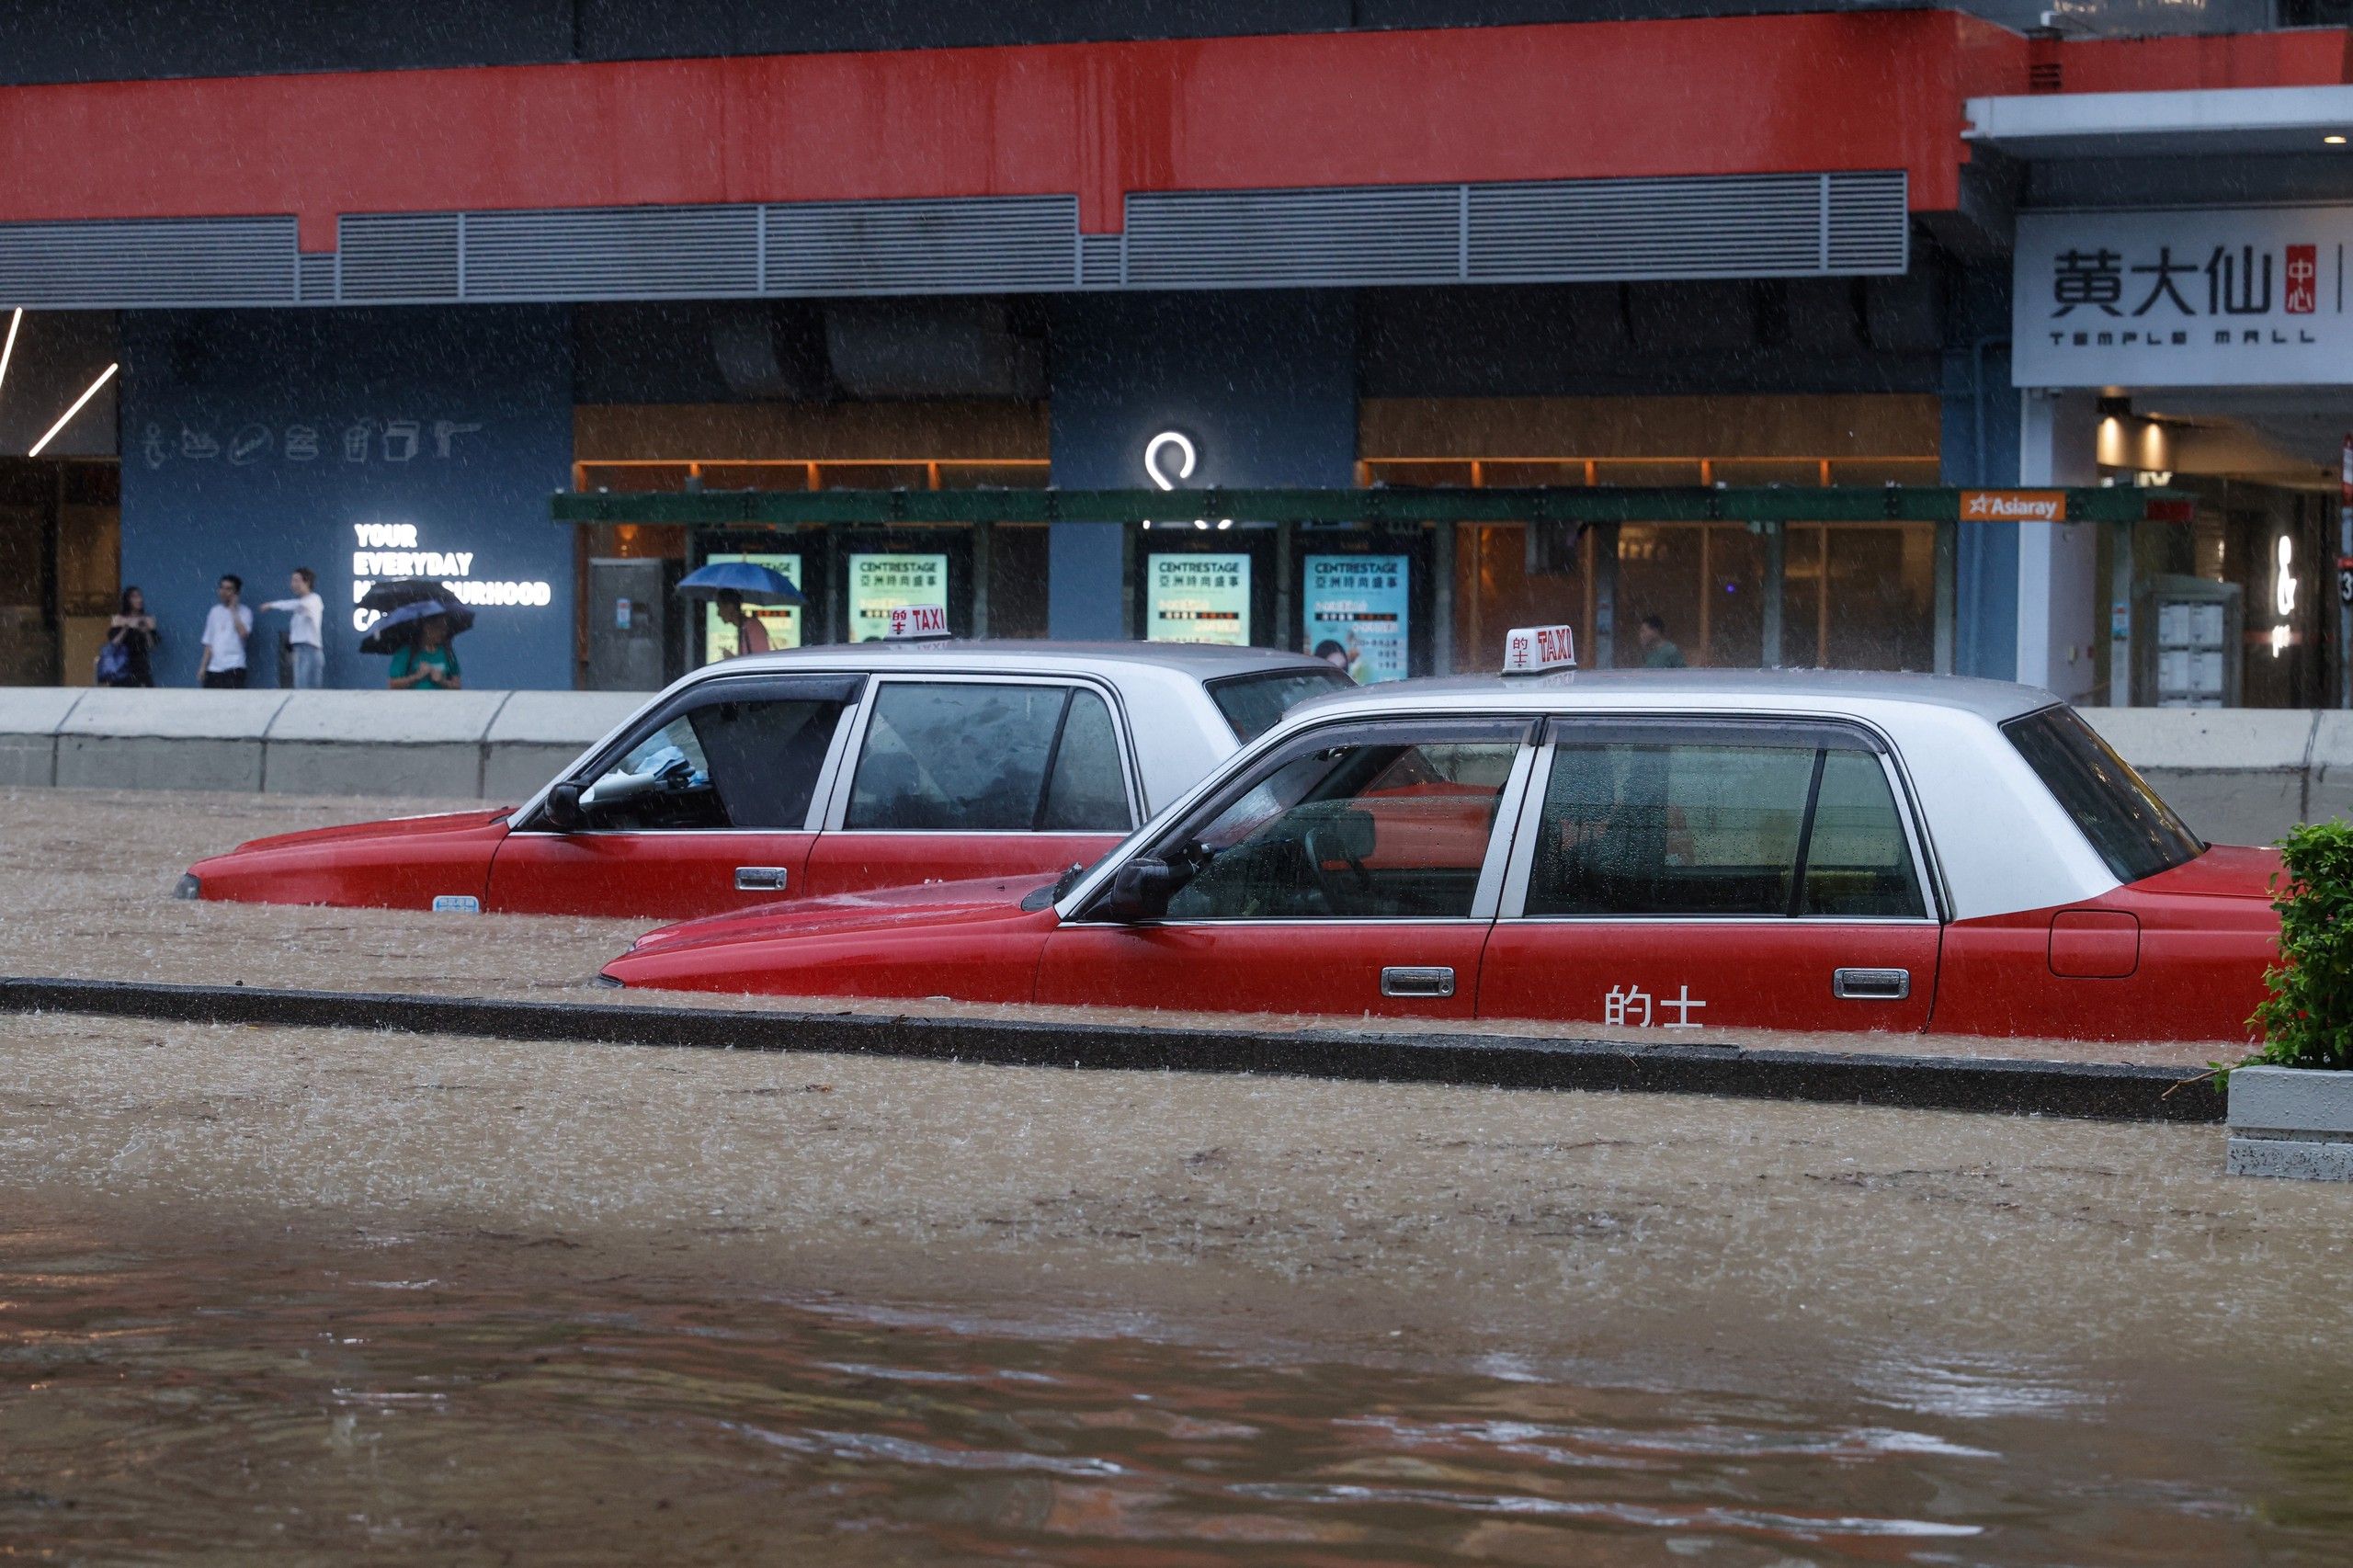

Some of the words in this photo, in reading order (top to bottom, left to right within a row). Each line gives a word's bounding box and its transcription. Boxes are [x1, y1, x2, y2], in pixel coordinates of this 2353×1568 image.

[2288, 258, 2313, 312] 中心
[2050, 331, 2188, 346] TEMPLE
[2215, 329, 2316, 345] MALL
[1991, 497, 2058, 519] Asiaray
[354, 523, 418, 548] YOUR
[353, 551, 474, 576] EVERYDAY
[860, 562, 937, 573] CENTRESTAGE
[1159, 562, 1238, 573] CENTRESTAGE
[1314, 562, 1398, 574] CENTRESTAGE
[913, 608, 945, 631] TAXI
[1512, 637, 1529, 664] 的士
[1538, 628, 1573, 663] TAXI
[1605, 984, 1707, 1028] 的士
